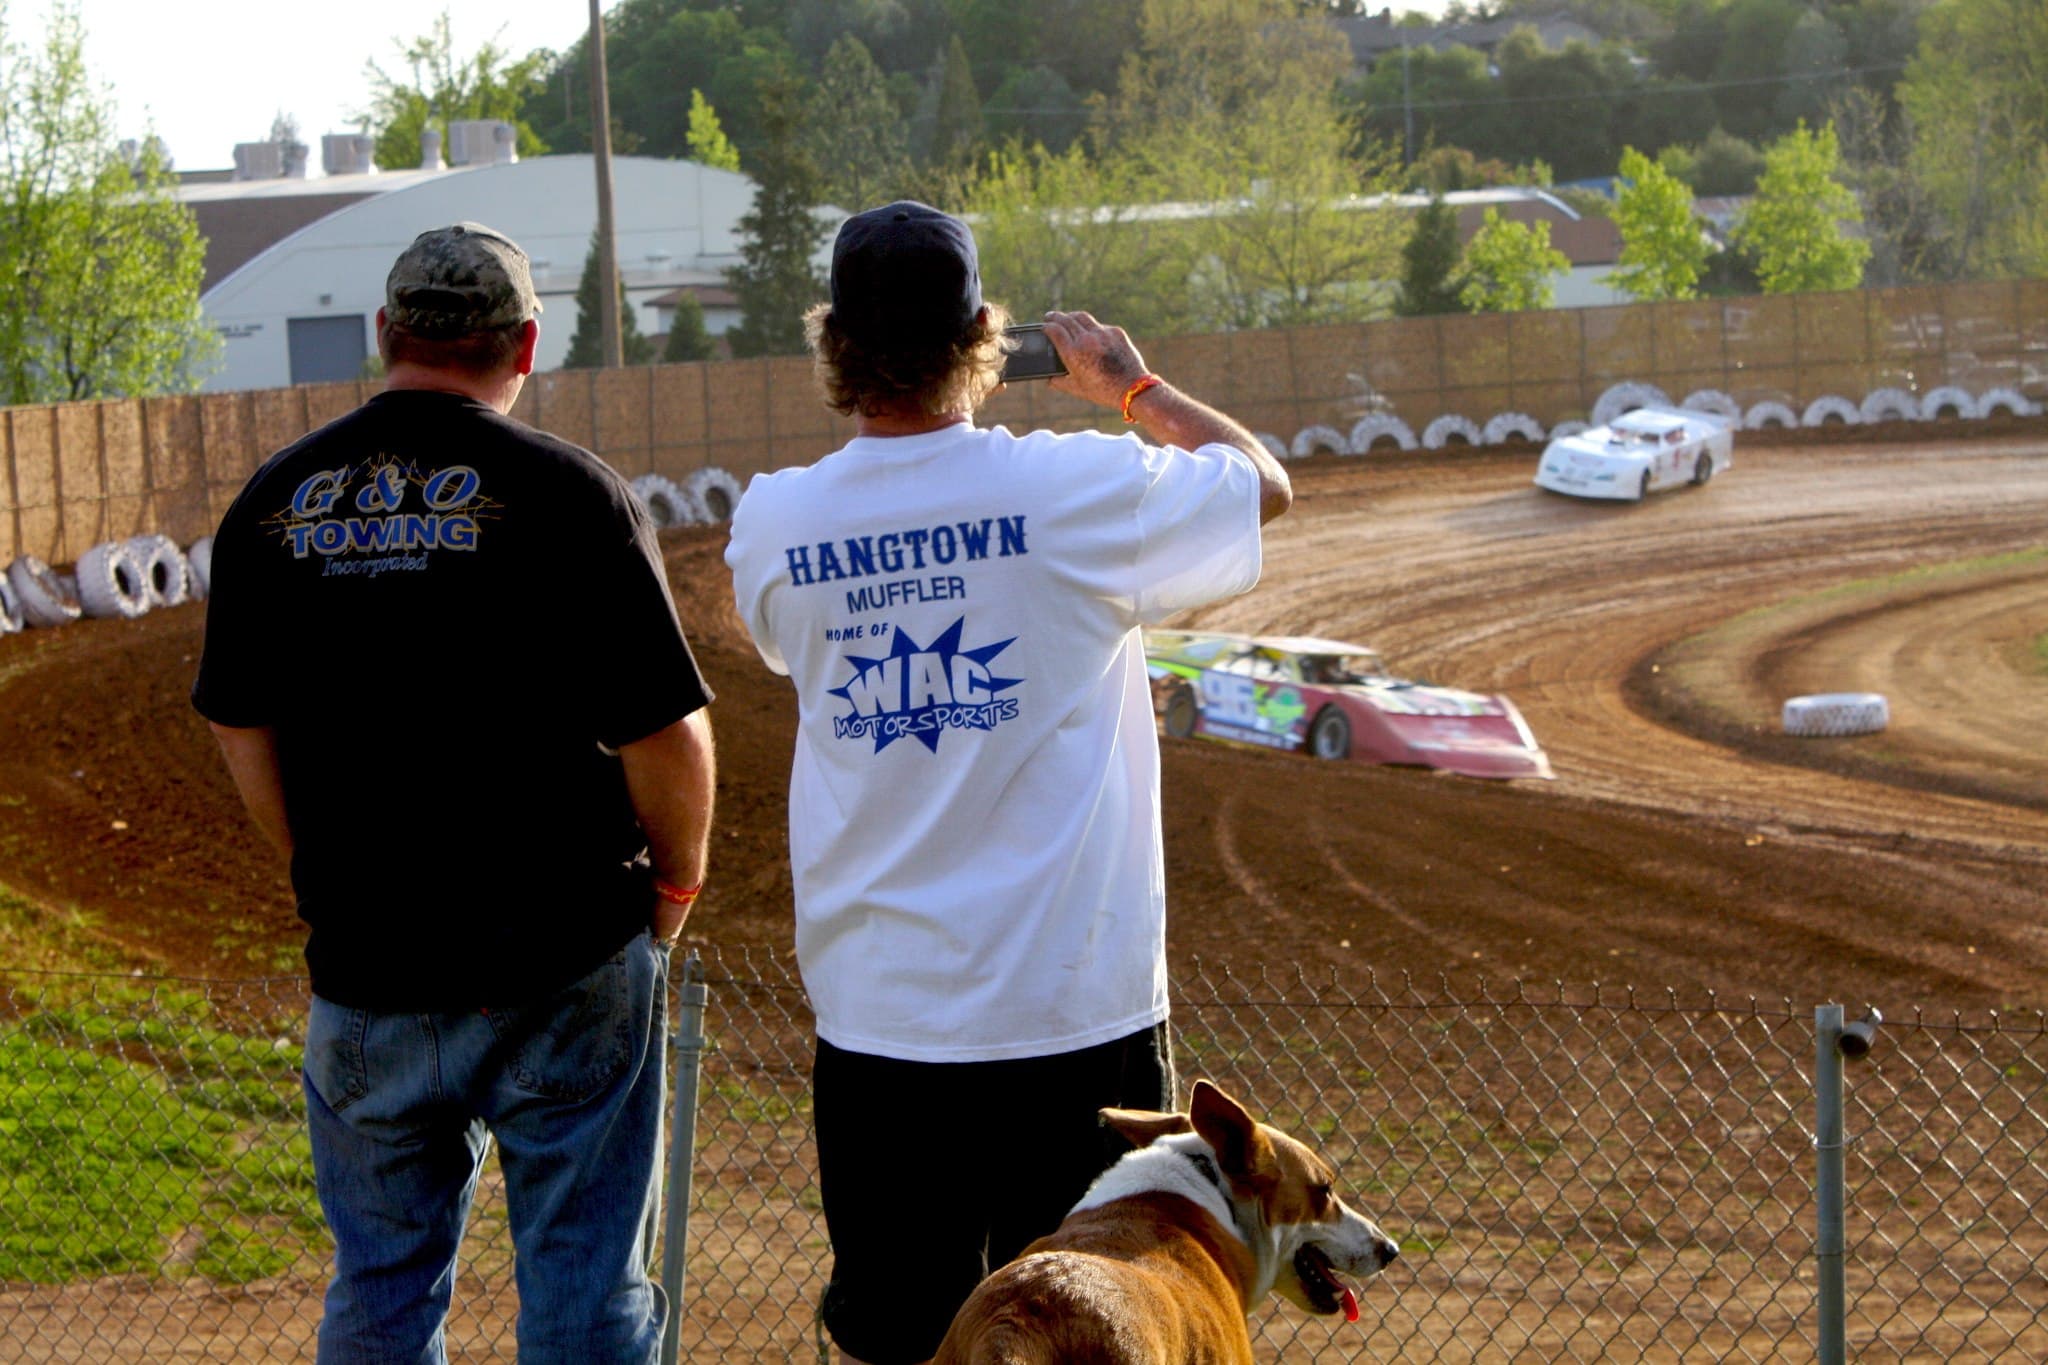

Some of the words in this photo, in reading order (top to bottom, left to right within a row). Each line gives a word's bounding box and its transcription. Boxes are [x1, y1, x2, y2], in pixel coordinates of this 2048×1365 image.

[291, 465, 347, 519] G
[355, 464, 408, 513] &
[423, 465, 481, 511] O
[286, 514, 478, 559] TOWING
[785, 515, 1029, 586] HANGTOWN
[321, 551, 430, 578] Incorporated
[846, 575, 966, 614] MUFFLER
[826, 626, 863, 641] HOME
[870, 622, 889, 636] OF
[846, 651, 992, 717] WAC
[833, 698, 1020, 739] MOTORSPORTS
